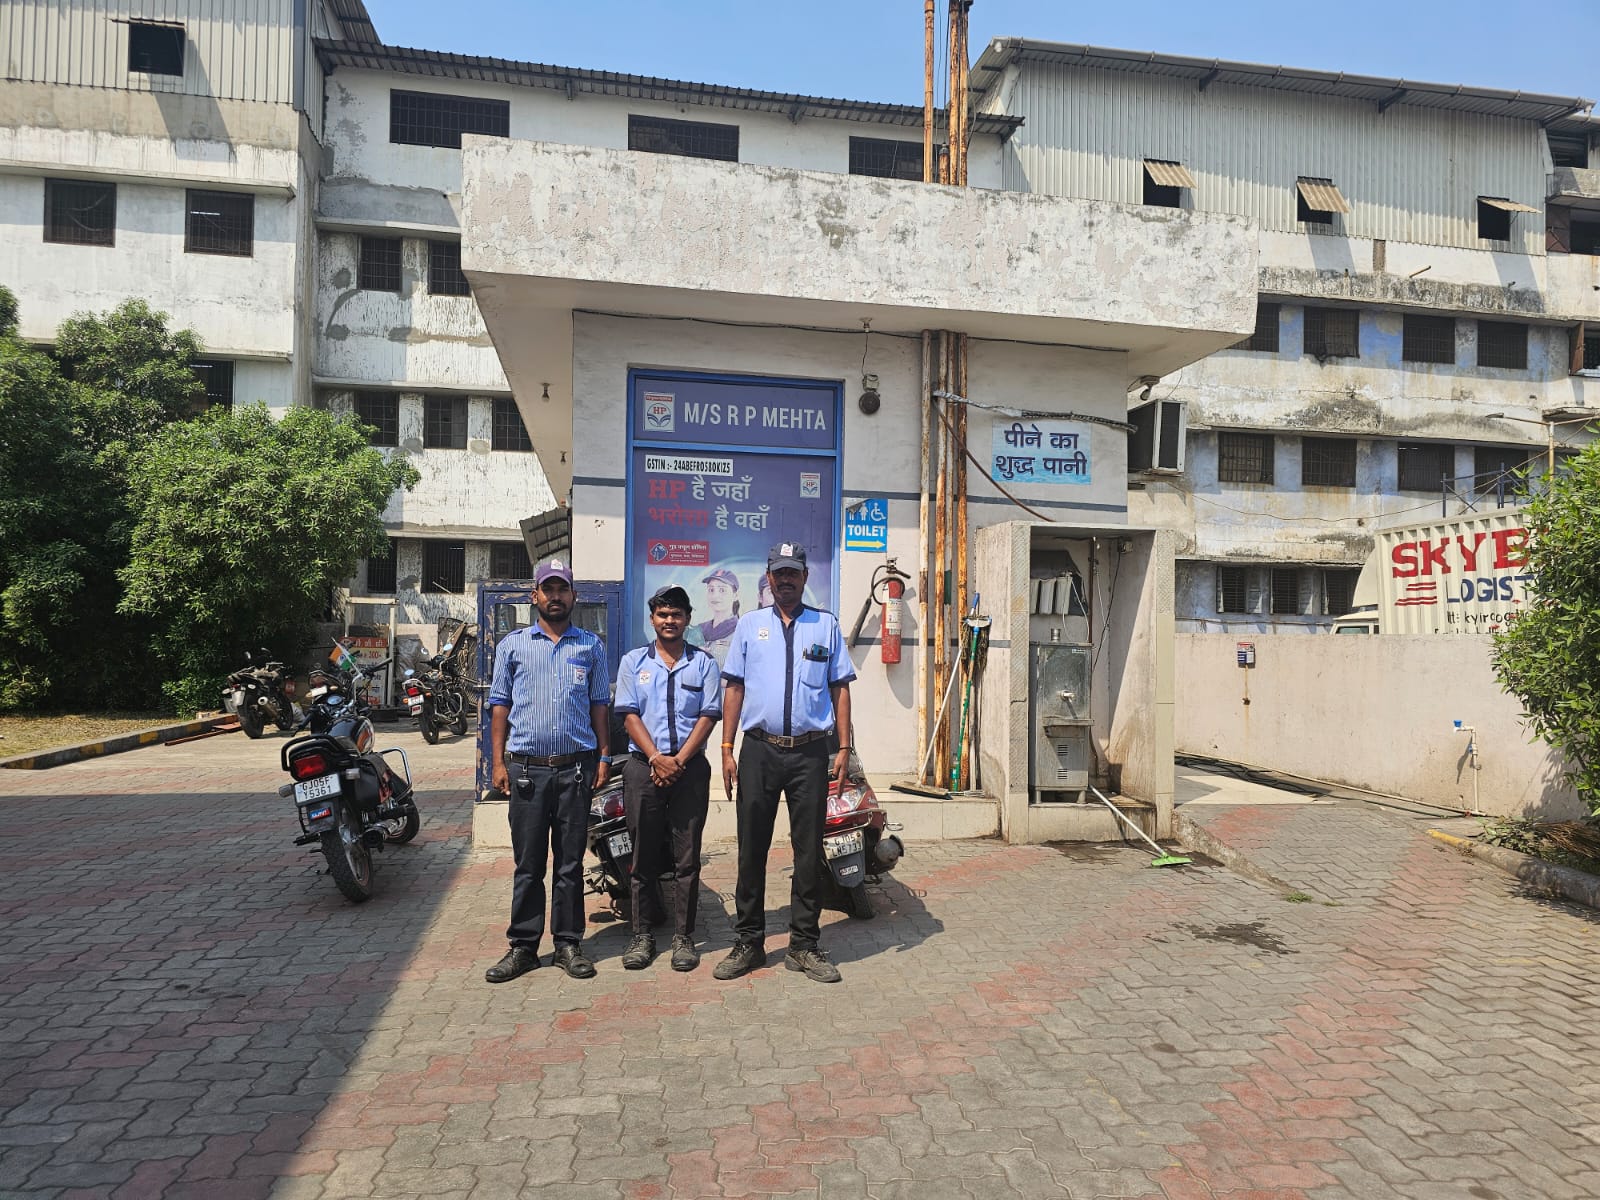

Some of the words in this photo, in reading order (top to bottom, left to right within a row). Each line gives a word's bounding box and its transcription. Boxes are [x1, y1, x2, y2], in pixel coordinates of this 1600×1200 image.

[684, 402, 721, 425] M/S
[728, 405, 739, 426] R
[745, 406, 757, 427] P
[762, 407, 827, 430] MEHTA
[1003, 422, 1042, 448] पीने
[1049, 432, 1079, 449] का
[646, 458, 666, 470] GSTIN
[996, 455, 1035, 480] शुद्ध
[1042, 451, 1087, 476] पानी
[648, 479, 687, 499] HP
[691, 475, 706, 501] है
[711, 475, 753, 502] जहाँ
[714, 504, 729, 530] है
[734, 504, 771, 531] वहाँ
[847, 524, 886, 537] TOILET
[1391, 527, 1531, 579] SKYB
